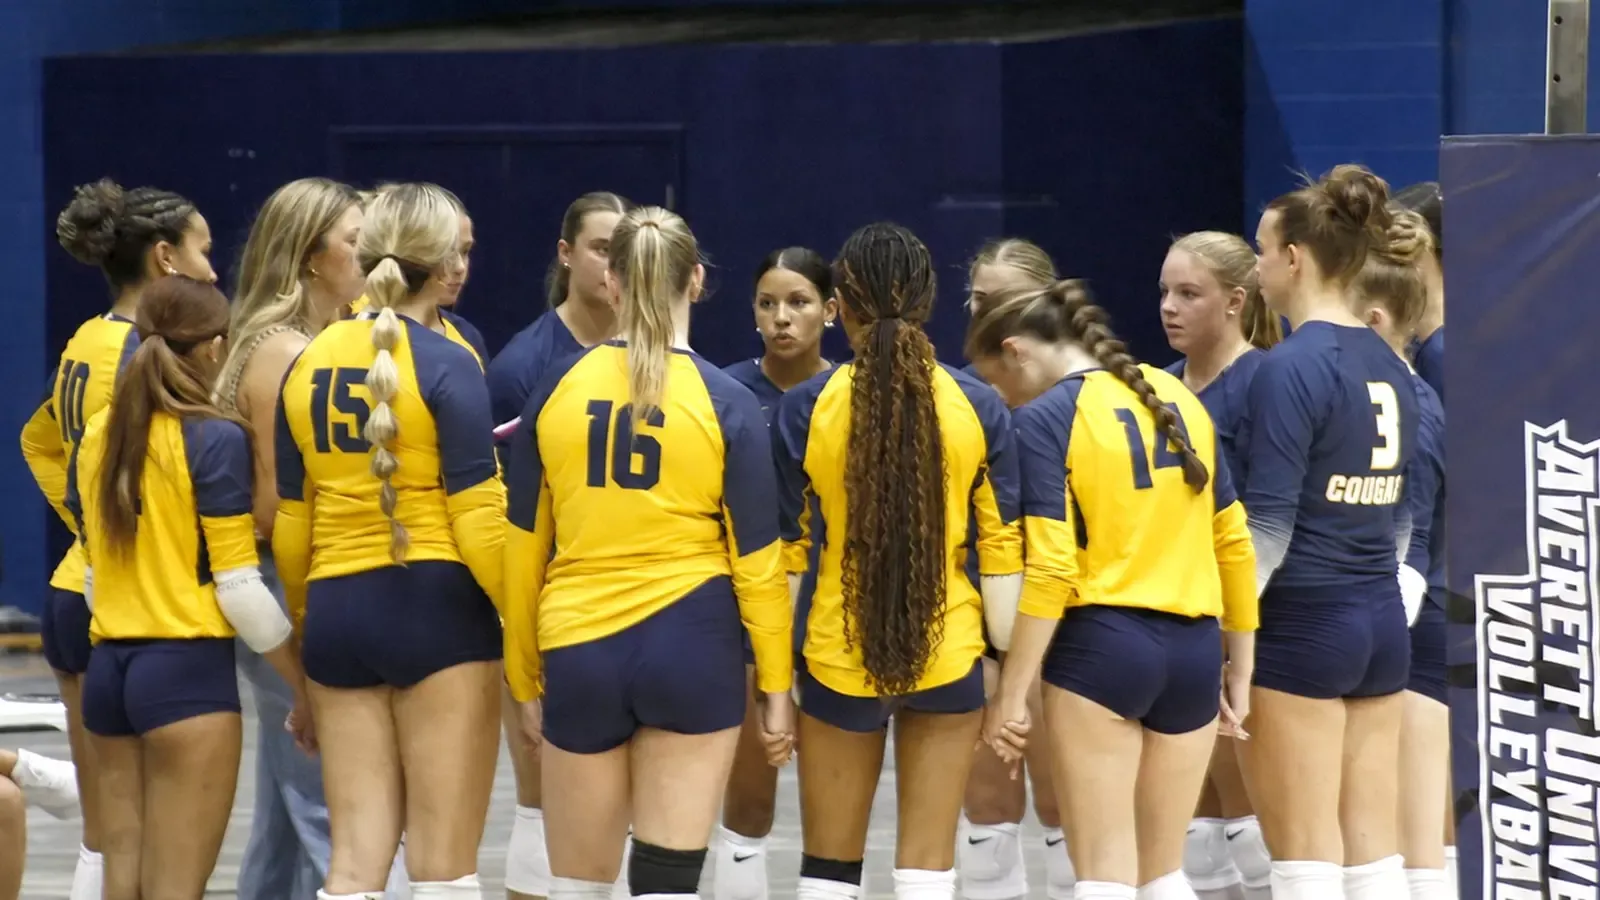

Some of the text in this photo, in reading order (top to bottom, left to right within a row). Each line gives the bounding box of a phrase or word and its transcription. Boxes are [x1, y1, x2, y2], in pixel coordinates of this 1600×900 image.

[60, 359, 90, 443] 10
[310, 367, 373, 454] 15
[586, 399, 665, 491] 16
[1366, 381, 1400, 471] 3
[1113, 402, 1193, 490] 14
[1537, 439, 1595, 720] AVERETT
